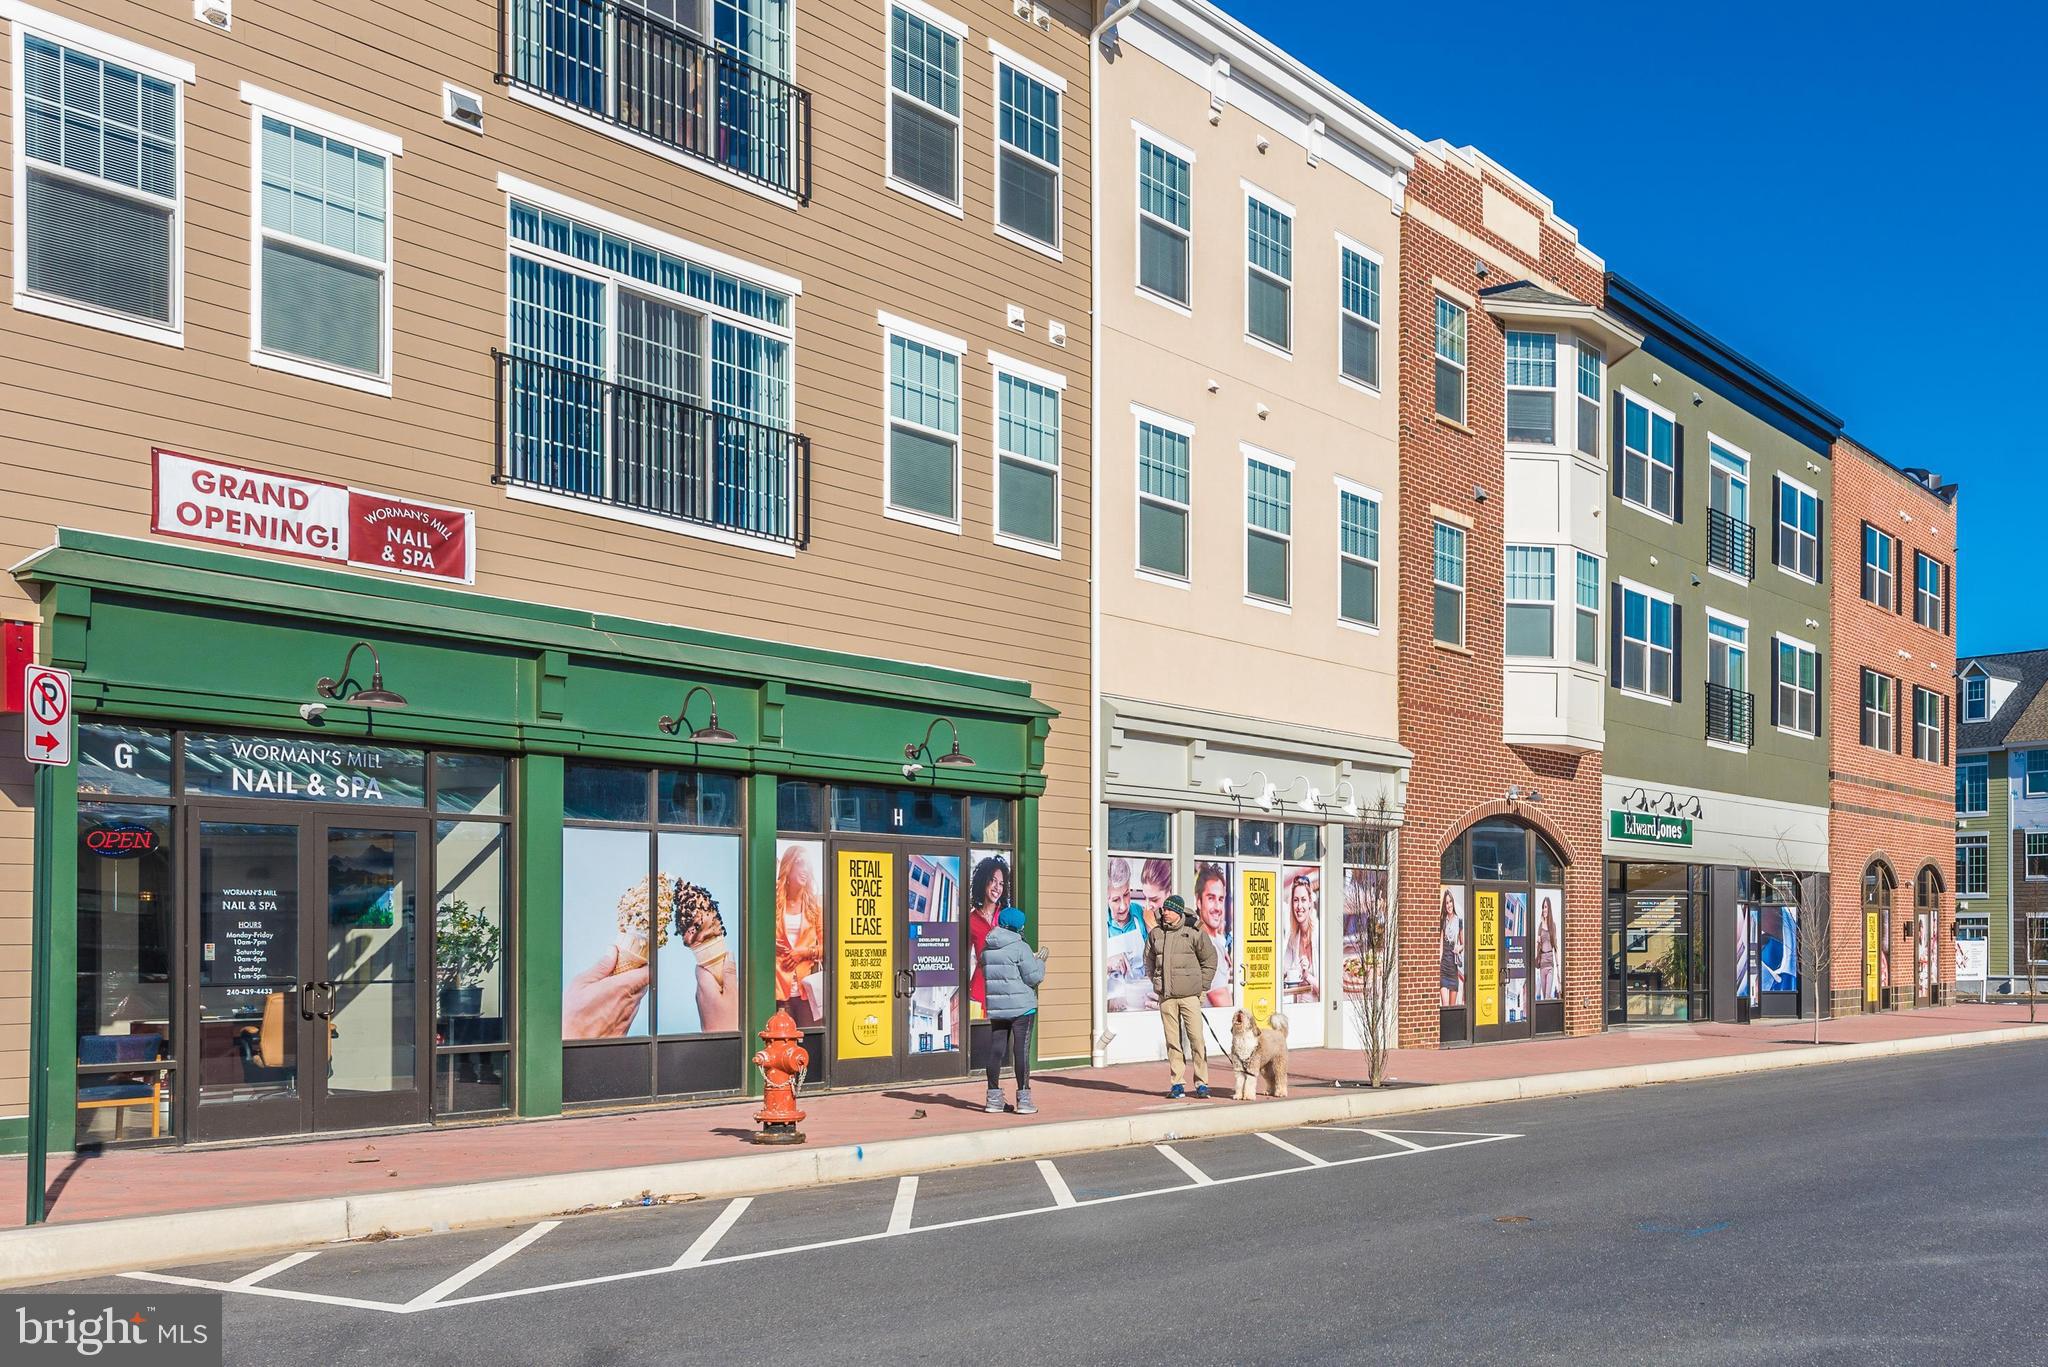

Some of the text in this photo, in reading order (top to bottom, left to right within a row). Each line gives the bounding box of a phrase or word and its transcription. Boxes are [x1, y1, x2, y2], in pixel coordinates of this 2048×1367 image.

[192, 470, 310, 511] GRAND
[176, 502, 339, 551] OPENING!
[364, 507, 453, 541] WORMAN'S MILL
[387, 526, 432, 549] NAIL
[381, 545, 435, 569] & SPA
[114, 743, 133, 769] G
[232, 742, 383, 769] WORMAN'S MILL
[232, 768, 383, 800] NAIL & SPA
[894, 808, 903, 826] H
[86, 831, 152, 850] OPEN
[1254, 831, 1260, 846] J
[849, 859, 883, 878] RETAIL
[850, 879, 882, 897] SPACE
[1249, 877, 1270, 892] RETAIL
[222, 889, 263, 897] WORMAN'S
[1249, 892, 1270, 907] SPACE
[222, 901, 278, 911] NAIL & SPA
[857, 898, 876, 917] FOR
[1480, 896, 1494, 909] RETAIL
[1253, 907, 1266, 922] FOR
[238, 921, 262, 929] HOURS
[850, 917, 882, 936] LEASE
[1249, 922, 1270, 937] LEASE
[226, 931, 274, 940] Monday-Friday
[233, 939, 267, 947] 10am-7pm
[236, 948, 265, 957] Saturday
[238, 965, 262, 974] Sunday
[912, 963, 955, 971] COMMERCIAL
